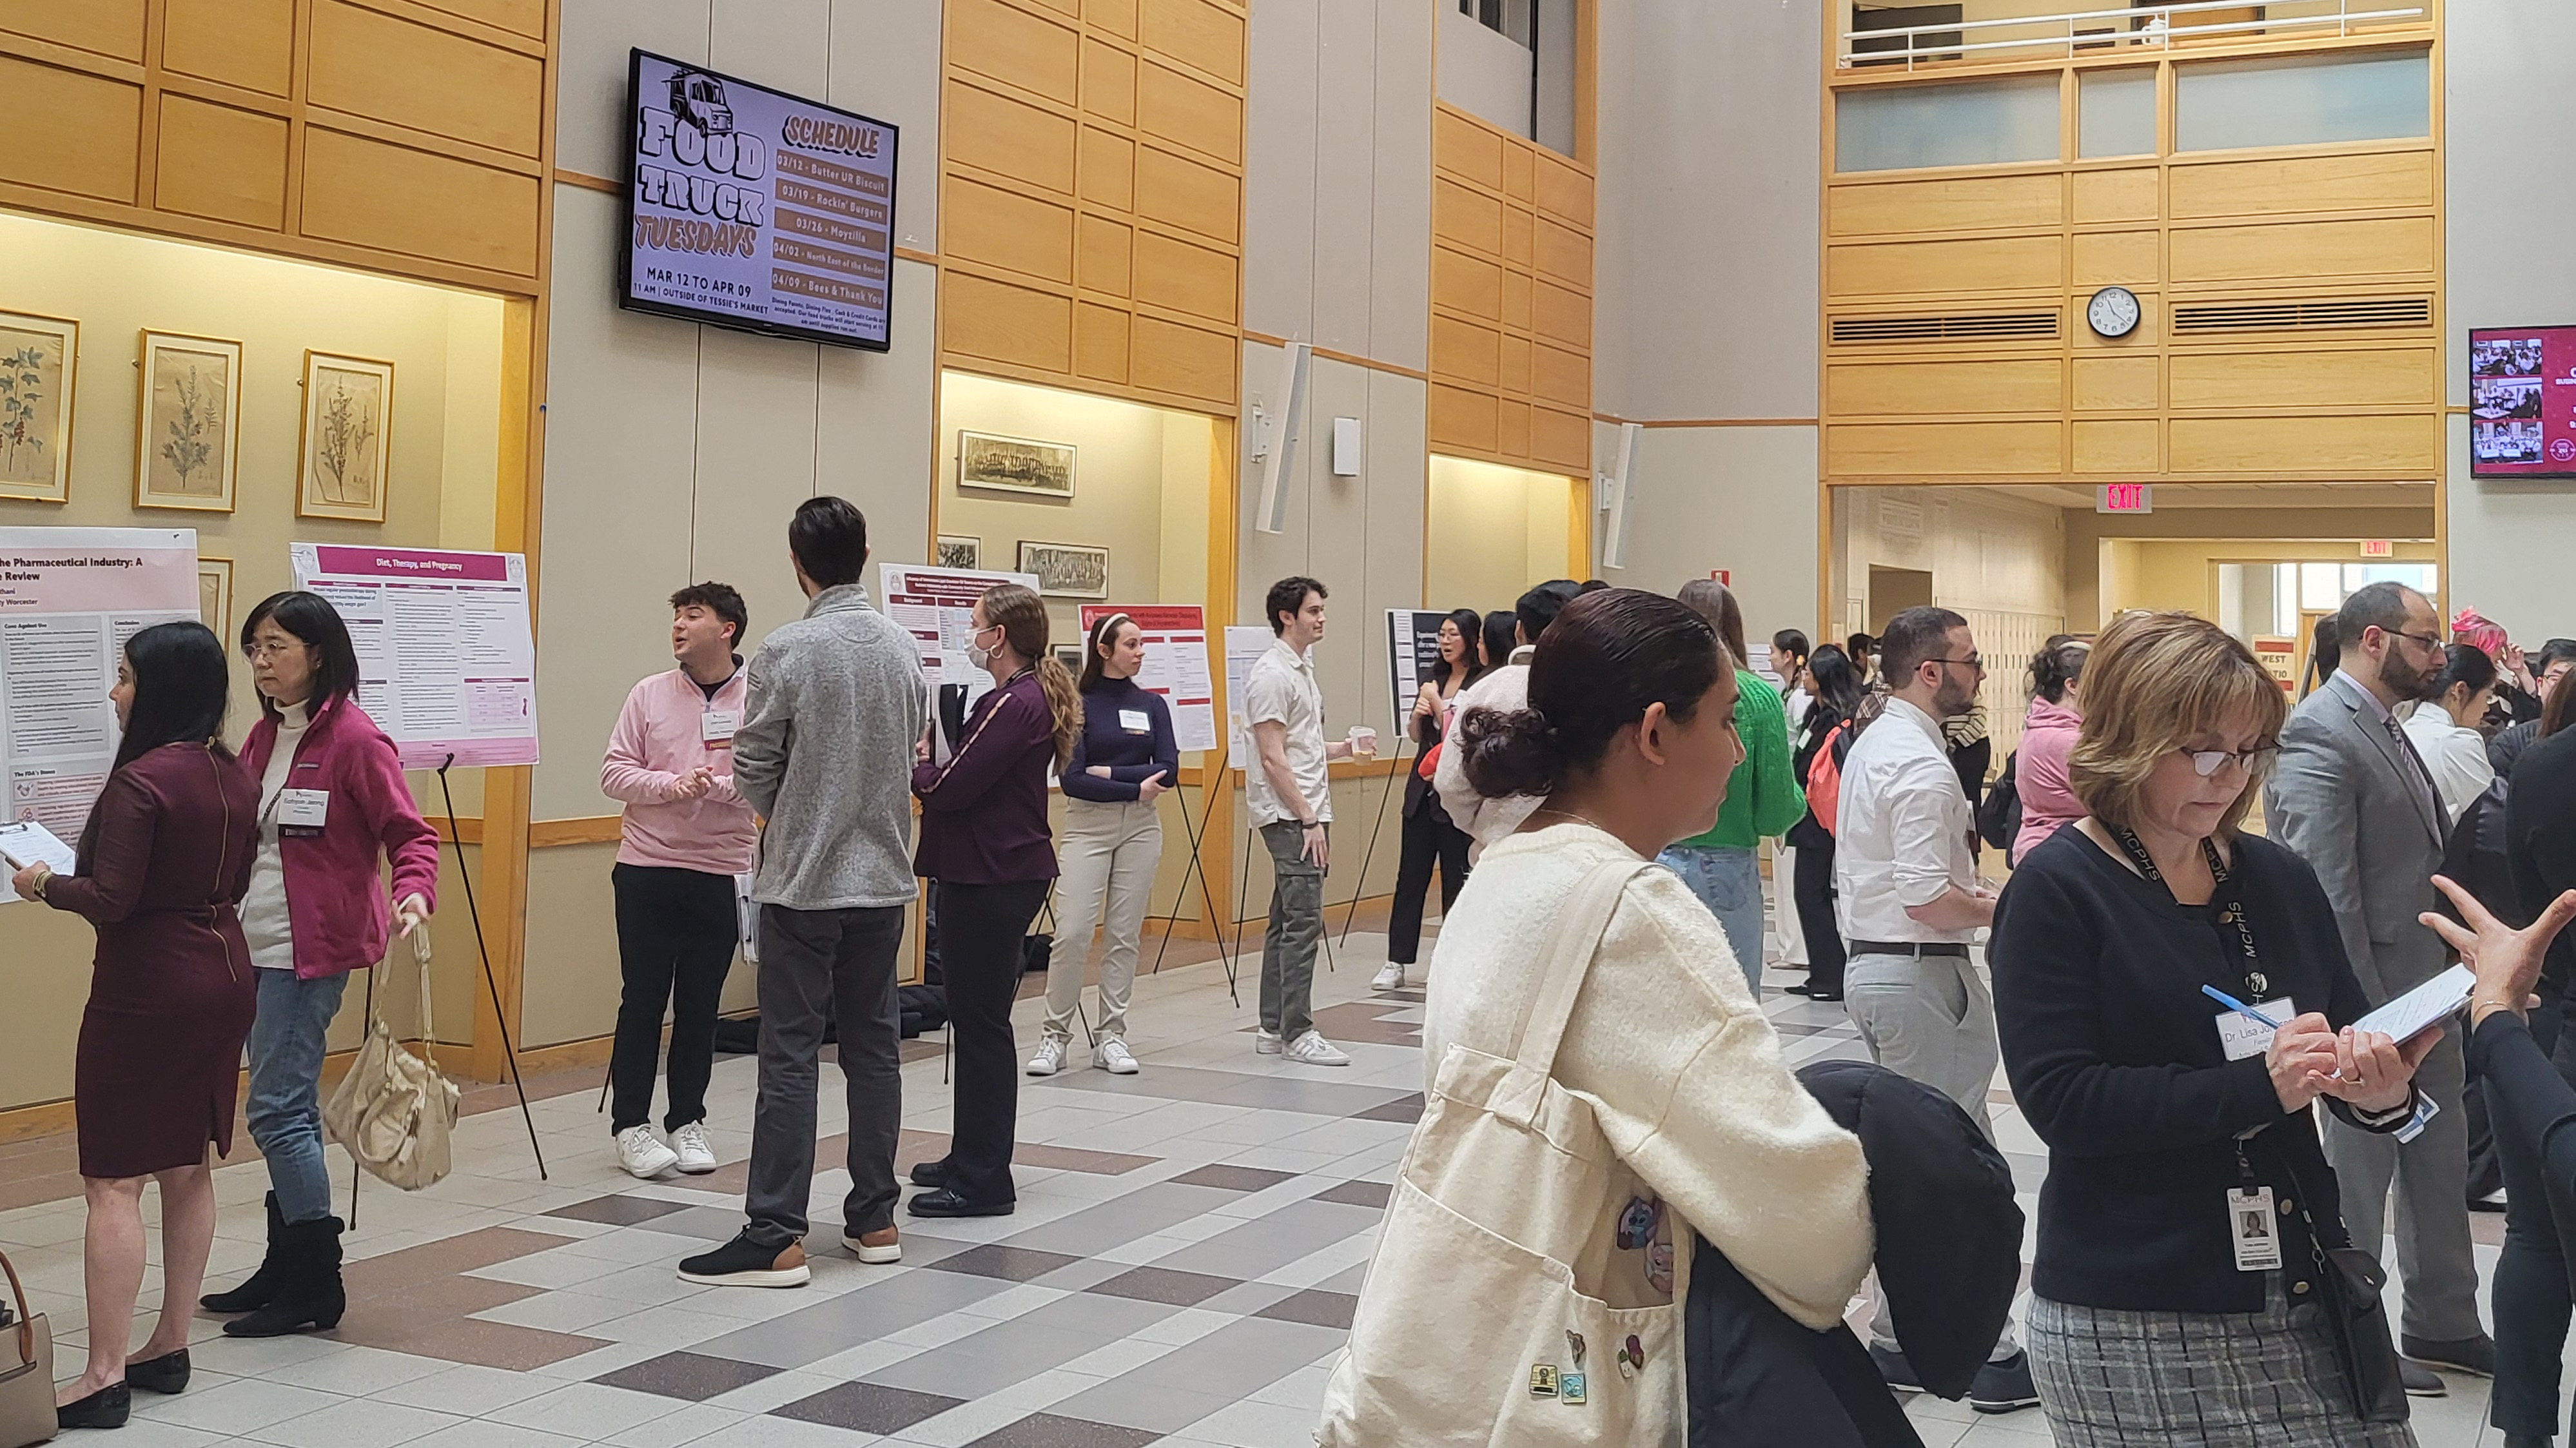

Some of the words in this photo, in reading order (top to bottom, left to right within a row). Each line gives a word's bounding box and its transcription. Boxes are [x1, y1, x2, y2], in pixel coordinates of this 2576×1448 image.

[639, 106, 766, 181] FOOD
[784, 116, 879, 156] SCHEDULE
[777, 155, 803, 170] 03/12
[811, 164, 839, 180] Butter
[841, 171, 854, 183] UR
[856, 176, 884, 191] Biscuit
[638, 163, 764, 228] TRUCK
[783, 185, 808, 200] 03/19
[817, 194, 848, 209] Rockin'
[850, 202, 883, 219] Burgers
[635, 214, 757, 258] TUESDAYS
[796, 217, 823, 233] 03/26
[831, 226, 866, 242] Moyzilla
[774, 242, 799, 257] 04/02
[806, 251, 826, 263] North
[827, 256, 841, 266] East
[851, 260, 861, 270] the
[863, 264, 884, 275] Border
[634, 282, 641, 292] 11
[644, 285, 656, 294] AM
[663, 288, 695, 301] OUTSIDE
[710, 297, 739, 309] TESSIE'S
[740, 302, 768, 315] MARKET
[647, 267, 672, 283] MAR
[677, 273, 688, 286] 12
[692, 276, 708, 289] TO
[712, 280, 734, 295] APR
[738, 284, 751, 298] 09
[773, 273, 800, 288] 04/09
[832, 286, 837, 296] &
[840, 286, 865, 301] Thank
[868, 293, 883, 305] You
[2107, 484, 2144, 510] EXIT
[14, 557, 88, 567] Pharmaceutical
[90, 557, 133, 569] Industry:
[135, 558, 143, 566] A
[2366, 541, 2386, 554] EXIT
[5, 571, 40, 580] Review
[376, 558, 392, 567] Diet,
[432, 562, 462, 572] Pregnancy
[2261, 655, 2286, 663] WEST
[2120, 827, 2161, 881] MCPHS
[2229, 902, 2257, 958] MCPHS
[2225, 1033, 2236, 1042] Dr
[2239, 1028, 2258, 1039] Lisa
